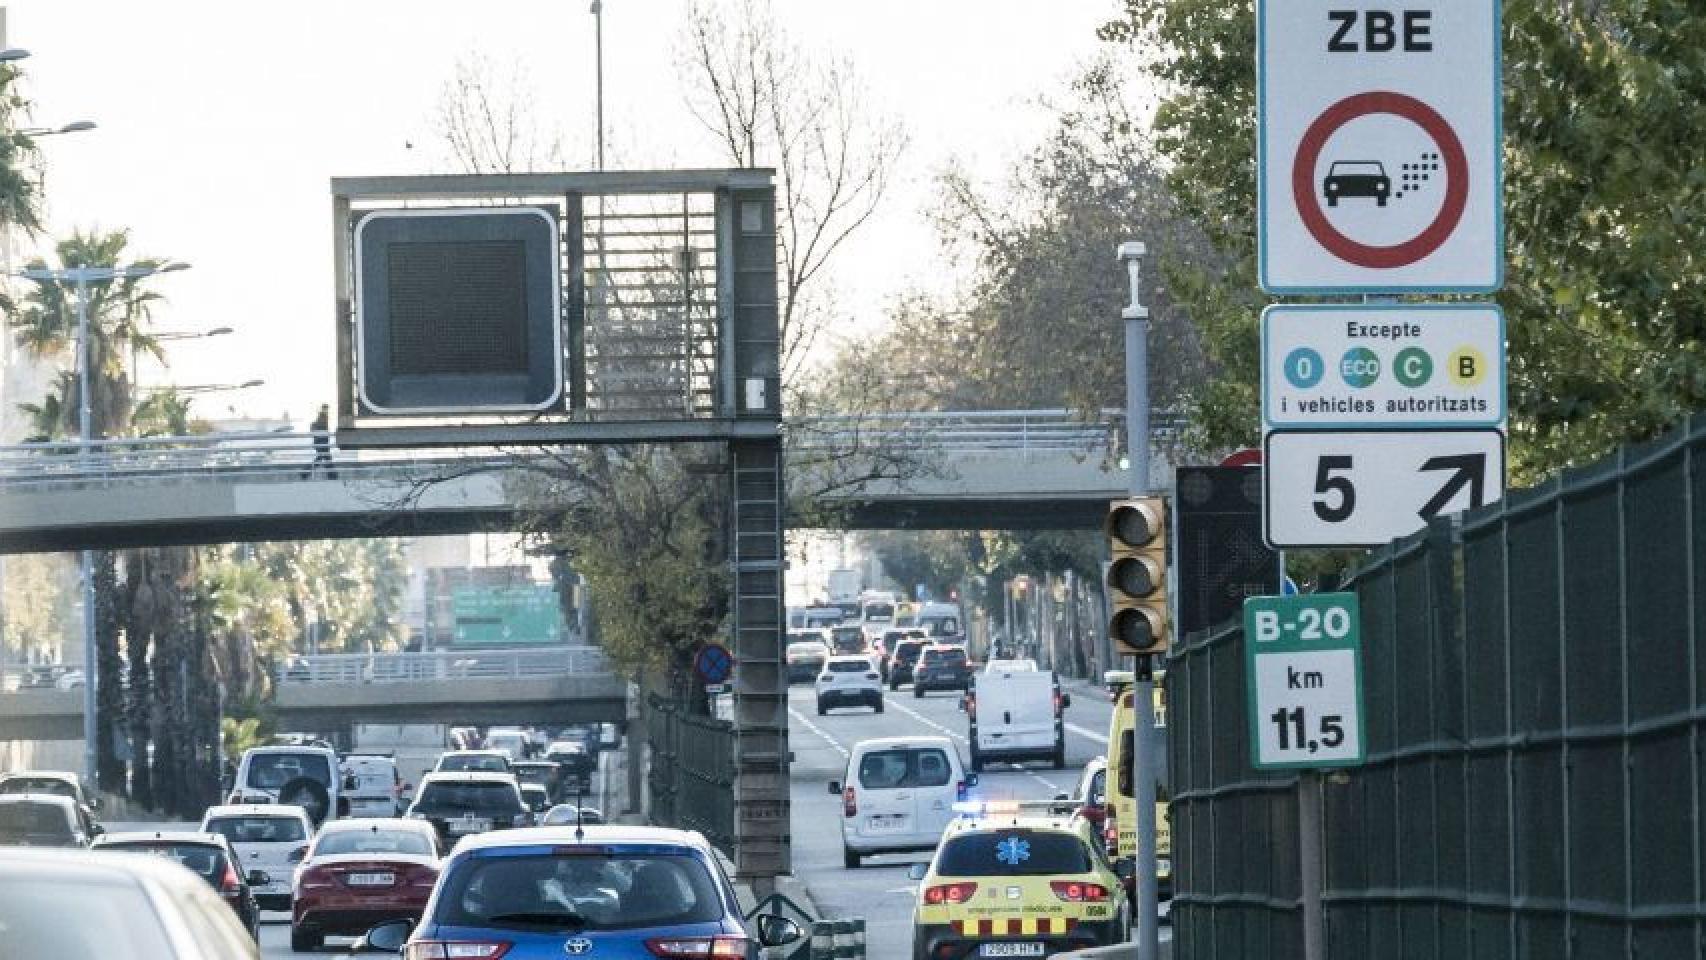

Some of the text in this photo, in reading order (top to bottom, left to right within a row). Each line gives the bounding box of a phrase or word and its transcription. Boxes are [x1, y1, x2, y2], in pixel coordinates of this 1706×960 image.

[1327, 9, 1433, 53] ZBE
[1346, 321, 1421, 340] Excepte
[1342, 360, 1379, 376] ECO
[1403, 356, 1422, 379] C
[1458, 355, 1475, 378] B
[1281, 396, 1487, 413] i vehicles autoritzats
[1311, 454, 1356, 523] 5
[1255, 606, 1351, 642] B-20
[1287, 665, 1323, 690] km
[1271, 705, 1345, 754] 11,5
